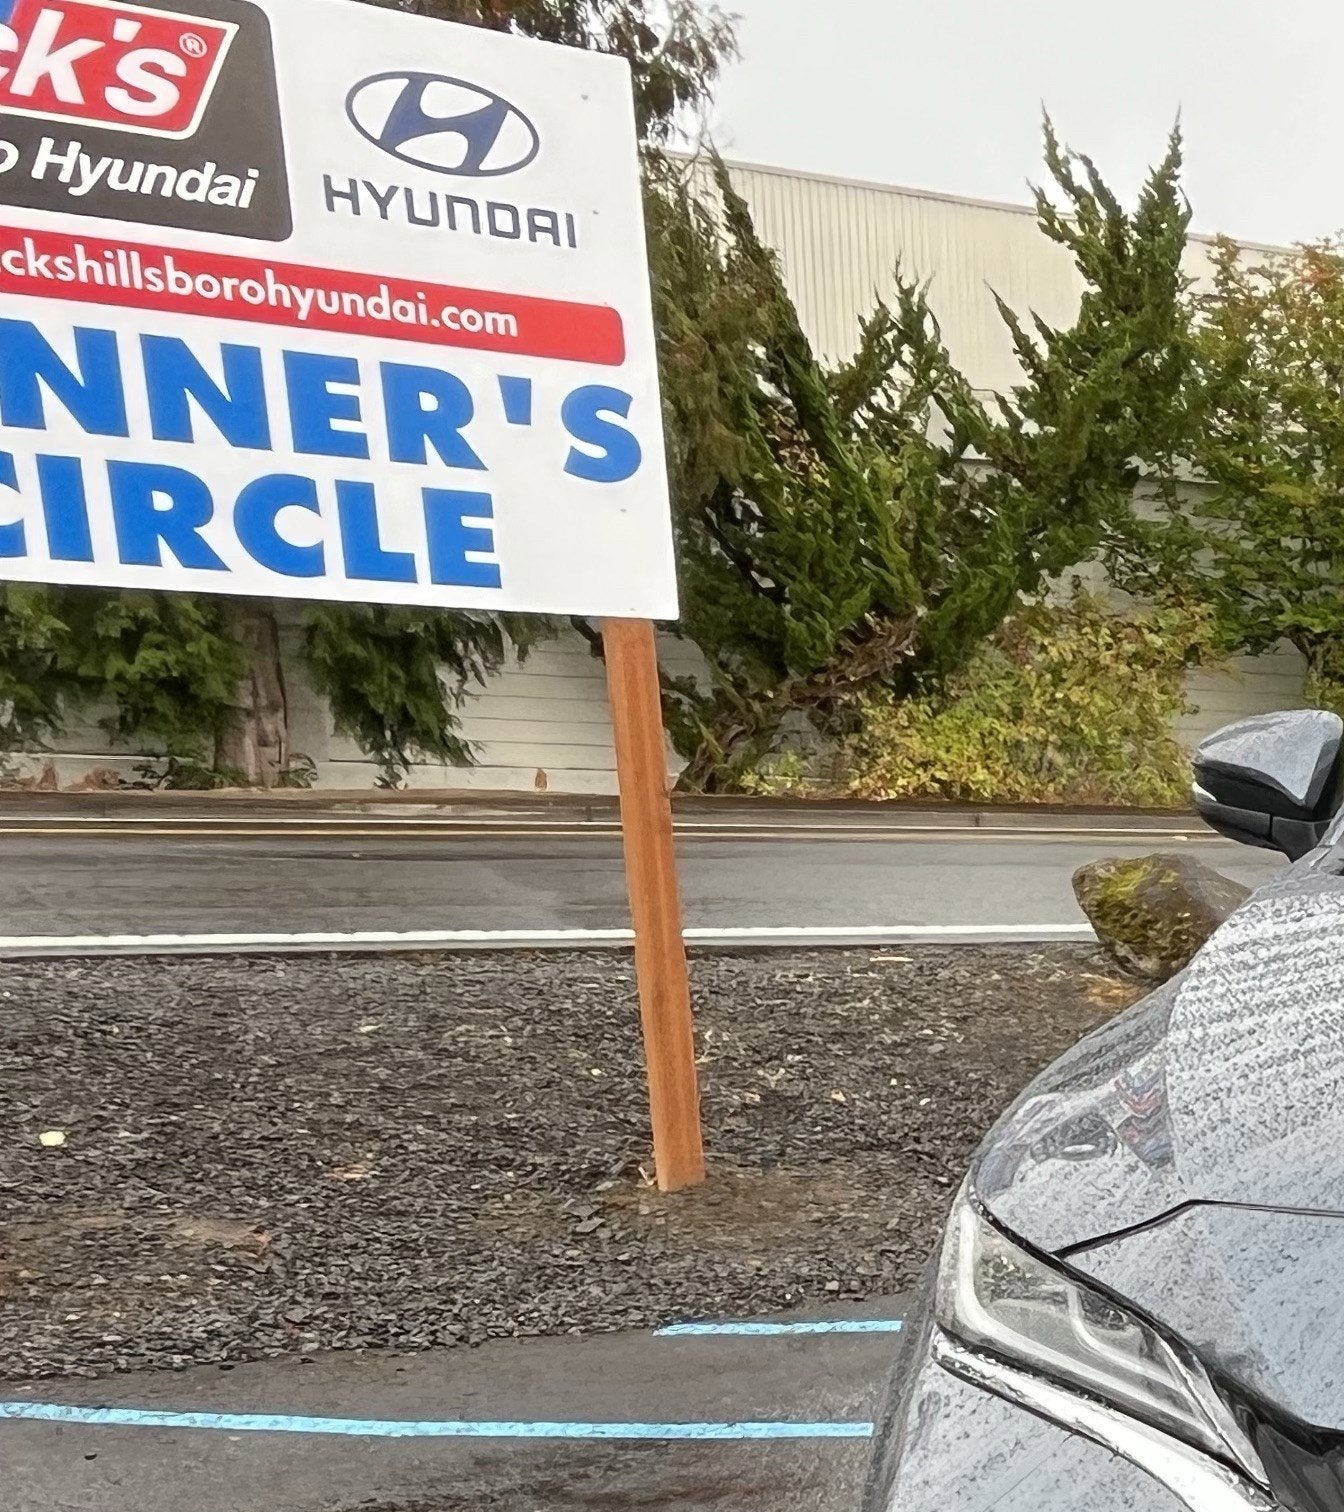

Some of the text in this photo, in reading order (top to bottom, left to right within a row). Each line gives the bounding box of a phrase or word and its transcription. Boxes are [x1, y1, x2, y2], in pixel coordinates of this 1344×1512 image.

[31, 137, 260, 209] Hyundai
[323, 174, 578, 249] HYUNDAI
[0, 318, 642, 484] NNER'S
